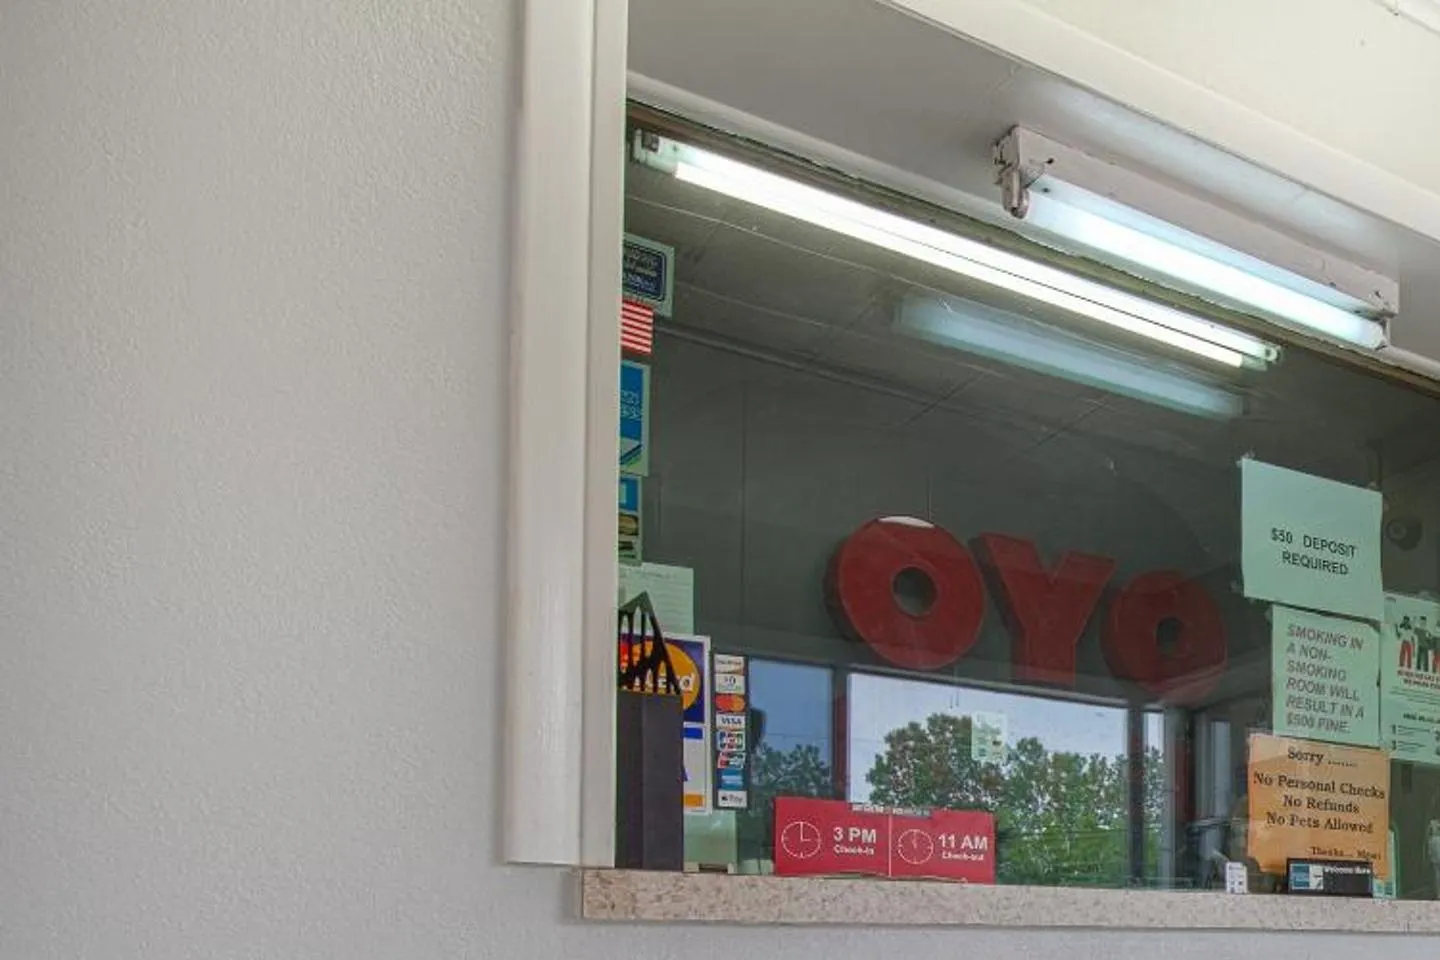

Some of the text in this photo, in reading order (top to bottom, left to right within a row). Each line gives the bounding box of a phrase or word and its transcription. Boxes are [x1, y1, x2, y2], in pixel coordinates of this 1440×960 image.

[1270, 527, 1357, 558] $50 DEPOSIT
[1281, 550, 1349, 576] REQUIRED
[823, 515, 1228, 708] OYO
[1286, 623, 1364, 651] SMOKING IN
[1286, 641, 1332, 661] A NON-
[1286, 659, 1347, 682] SMOKING
[1286, 677, 1360, 702] ROOM WILL
[1286, 694, 1365, 720] RESULT IN A
[1287, 746, 1324, 766] Sorry
[1253, 771, 1385, 800] No Personal Checks
[1283, 794, 1360, 814] No Refunds
[1266, 811, 1375, 834] No Pets Allowed
[832, 827, 877, 844] 3 PM
[938, 834, 988, 851] 11 AM
